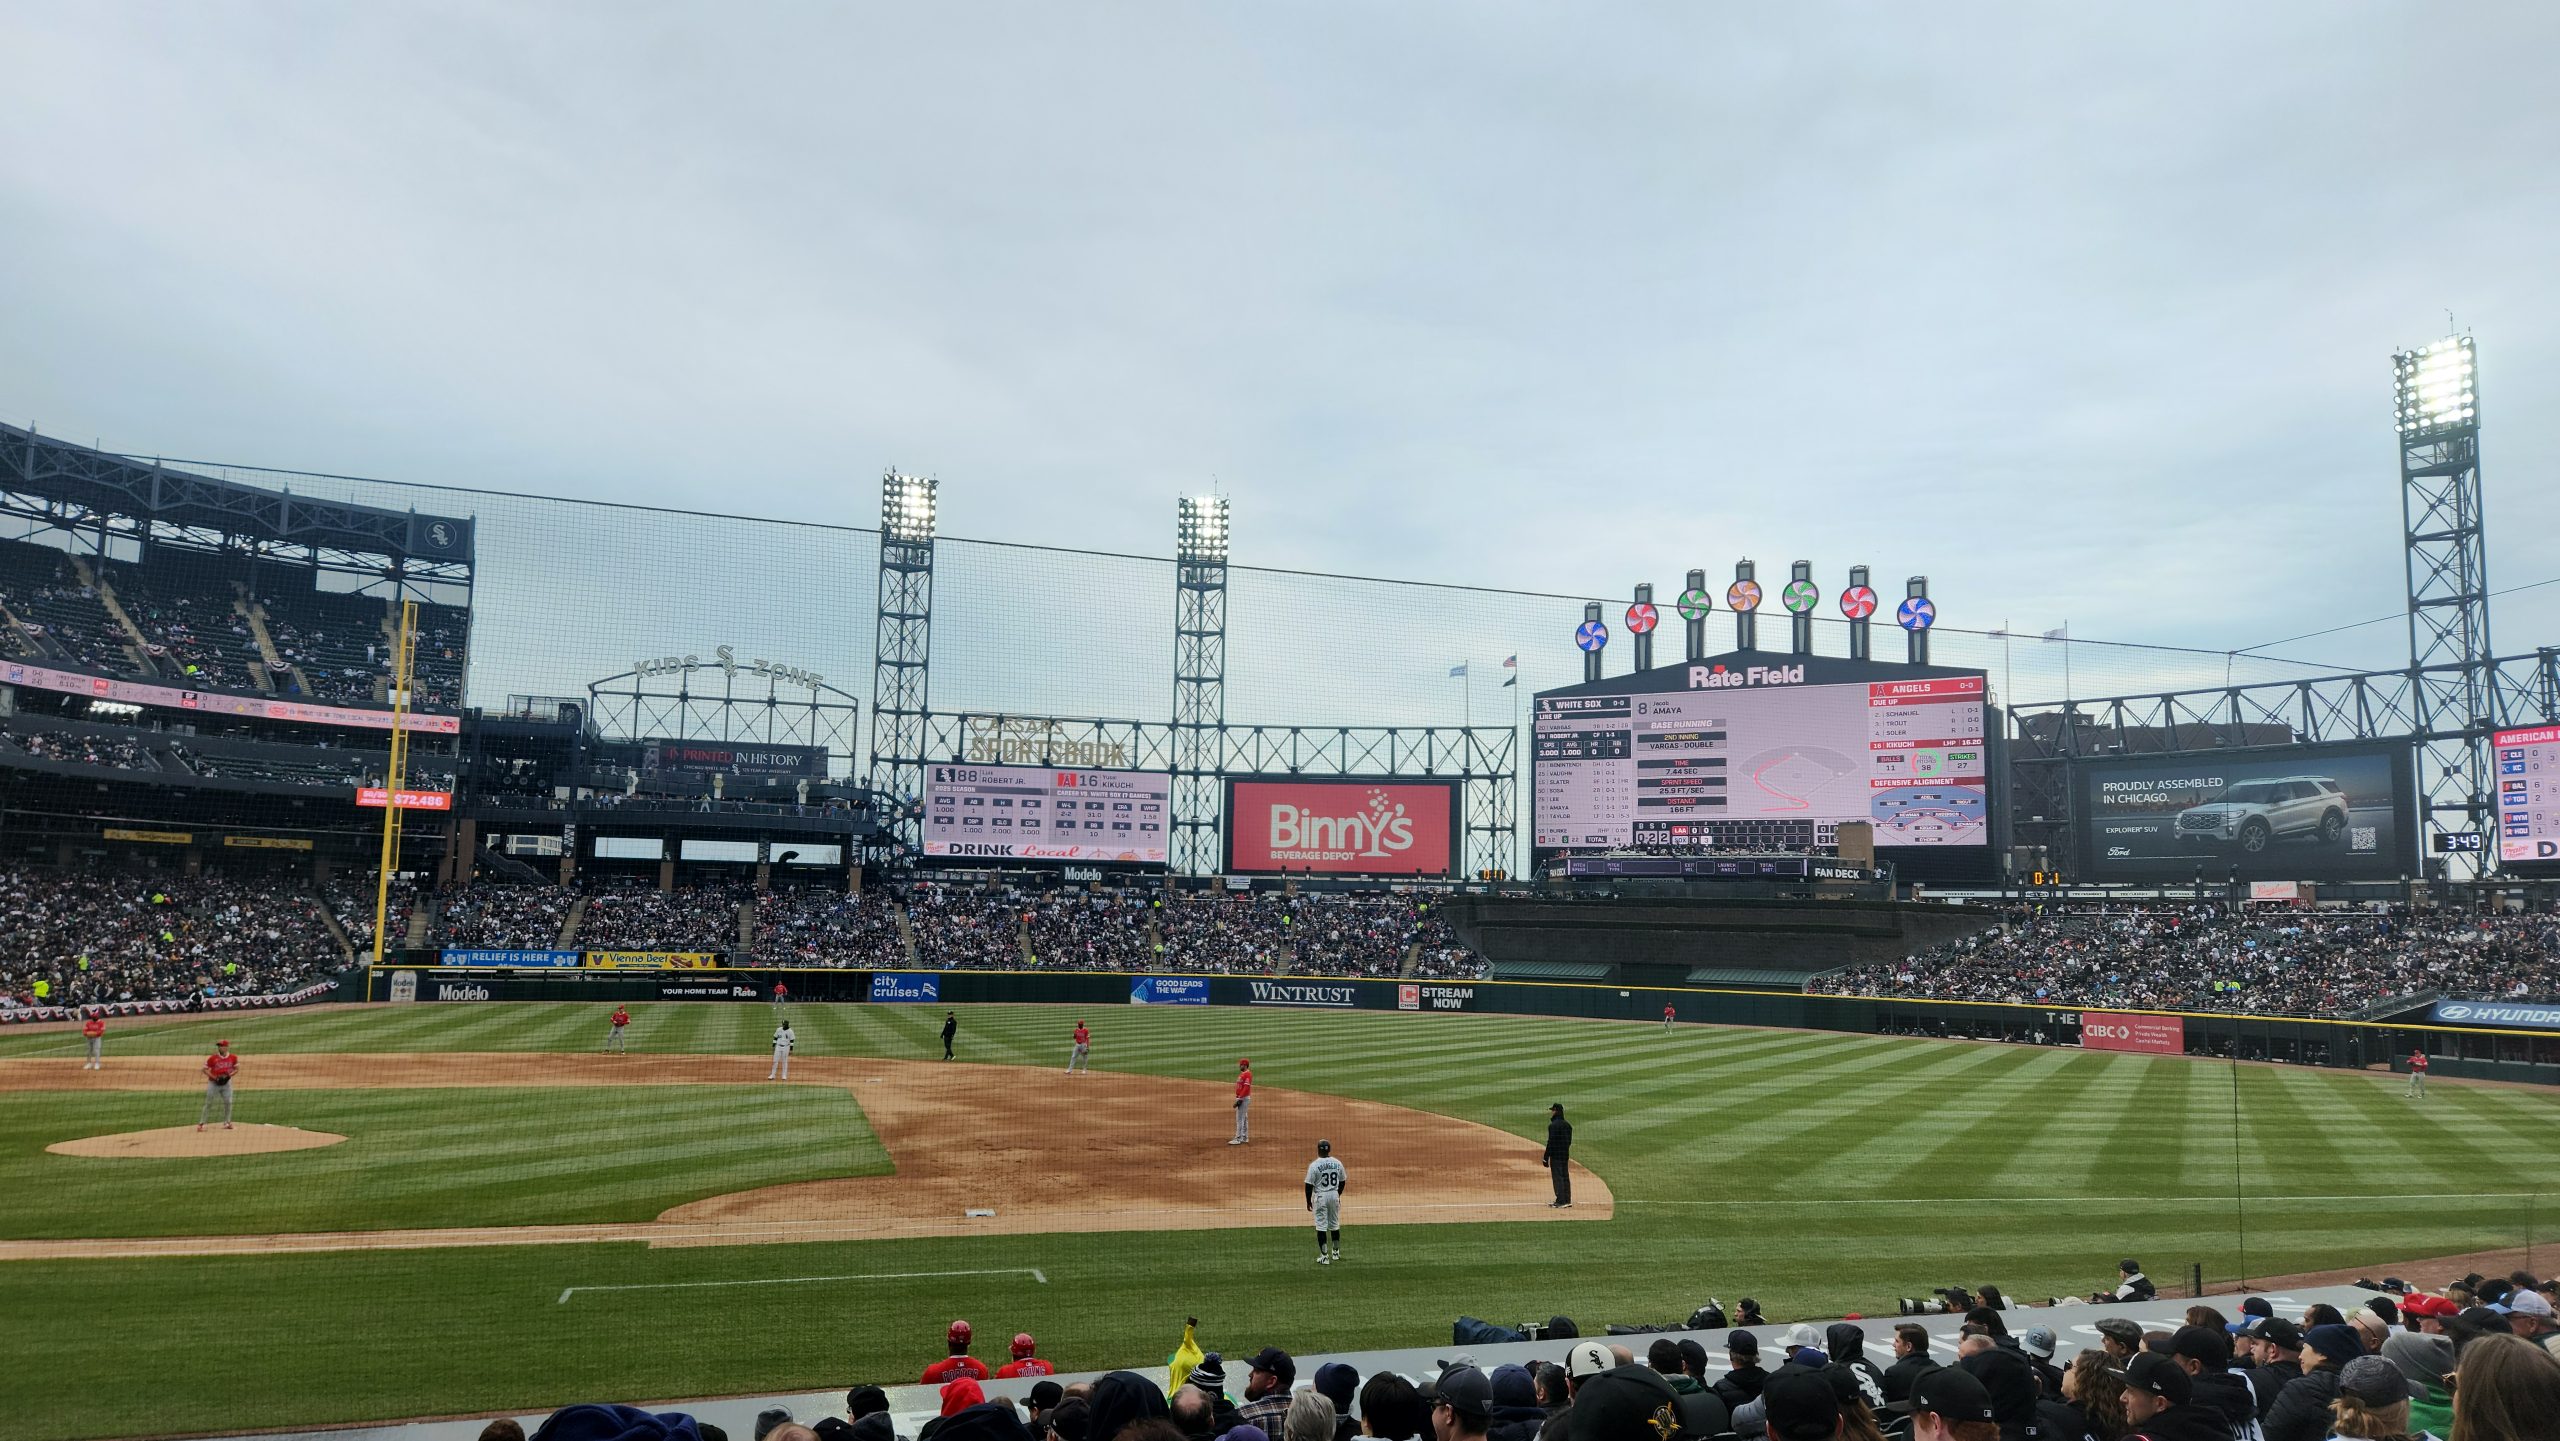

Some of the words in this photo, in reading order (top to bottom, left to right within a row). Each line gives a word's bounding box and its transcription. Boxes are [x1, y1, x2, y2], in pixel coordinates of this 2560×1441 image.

[634, 655, 700, 678] KIDS
[752, 659, 824, 691] ZONE
[1689, 665, 1744, 688] Rate
[1747, 665, 1804, 685] Field
[1892, 684, 1931, 693] ANGELS
[1556, 701, 1582, 709] WHITE
[1585, 700, 1601, 708] SOX
[1638, 703, 1647, 715] 8
[1653, 707, 1682, 715] AMAYA
[973, 716, 1064, 735] CAESARS
[1651, 721, 1673, 729] BASE
[1674, 720, 1713, 728] RUNNING
[2500, 731, 2555, 745] AMERICAN
[683, 749, 733, 763] PRINTED
[736, 752, 748, 763] IN
[971, 737, 1125, 767] SPORTSBOOK
[958, 770, 978, 782] 88
[1080, 775, 1098, 787] 16
[2103, 781, 2154, 792] PROUDLY
[2157, 777, 2224, 789] ASSEMBLED
[1677, 787, 1705, 795] FT/SEC
[394, 794, 444, 806] $72,486
[2103, 794, 2115, 804] IN
[2118, 793, 2170, 804] CHICAGO.
[1271, 804, 1414, 857] Binny's
[1638, 833, 1655, 842] 0-2
[1661, 833, 1668, 842] 2
[2447, 835, 2481, 850] 3:49
[949, 843, 1014, 856] DRINK
[1020, 846, 1080, 858] Local
[1271, 851, 1321, 860] BEVERAGE
[1323, 852, 1355, 861] DEPOT
[2107, 847, 2131, 856] Ford
[1065, 867, 1102, 881] Modelo
[1815, 868, 1833, 877] FAN
[1835, 869, 1859, 879] DECK
[472, 953, 507, 961] RELIEF
[510, 953, 519, 961] IS
[522, 953, 550, 962] HERE
[609, 953, 643, 962] Vienna
[646, 953, 669, 962] Beef
[874, 976, 898, 988] city
[439, 985, 489, 1001] Modelo
[733, 987, 757, 997] Rate
[874, 987, 919, 997] cruises
[1250, 982, 1355, 1002] WINTRUST
[1422, 987, 1473, 999] STREAM
[1433, 999, 1462, 1009] NOW
[2474, 1008, 2560, 1022] HYUNDA
[2086, 1025, 2116, 1038] CIBC
[1322, 1172, 1338, 1187] 38
[1017, 1366, 1046, 1377] YOUNG
